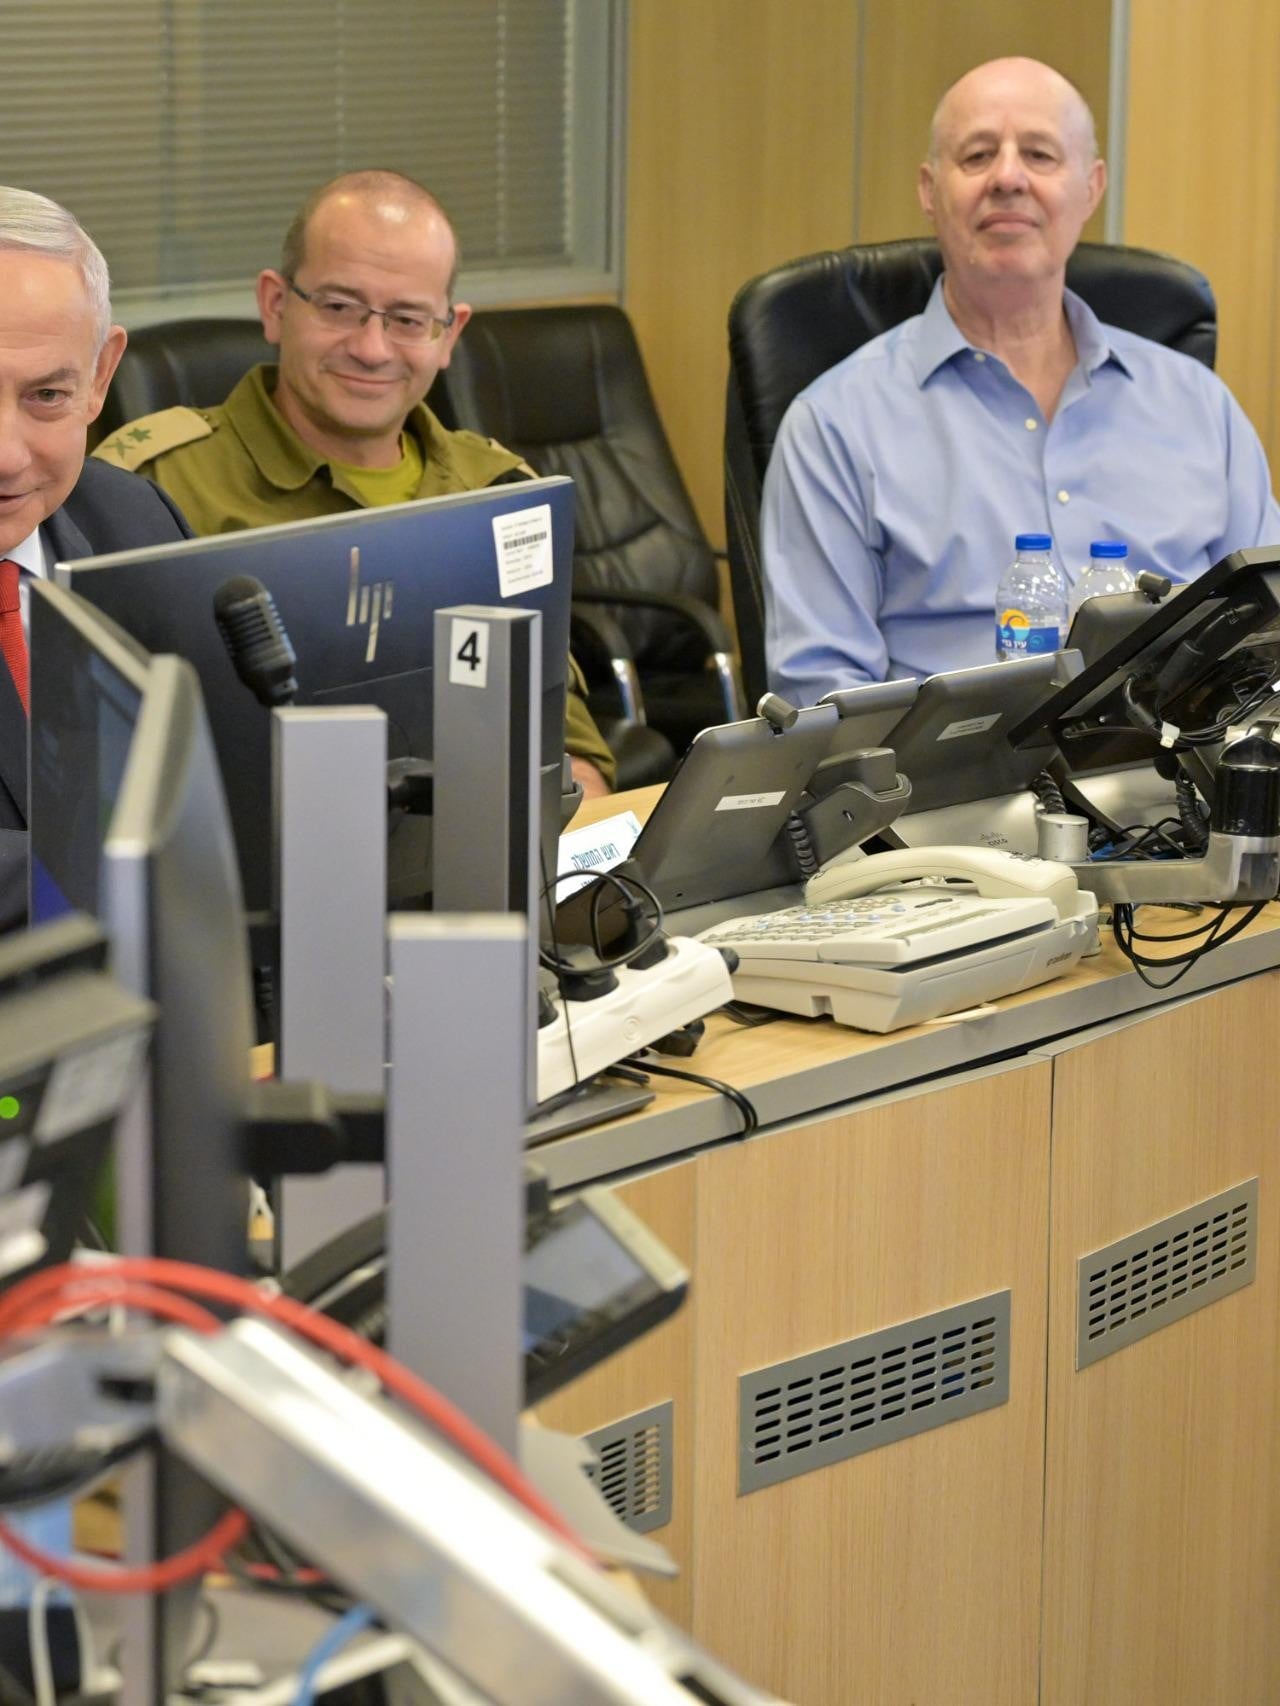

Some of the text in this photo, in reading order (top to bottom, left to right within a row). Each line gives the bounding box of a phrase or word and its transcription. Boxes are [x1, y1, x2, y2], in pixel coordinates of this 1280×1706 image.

[346, 546, 394, 662] hp
[457, 631, 480, 671] 4
[570, 842, 621, 872] ראש הממשלה
